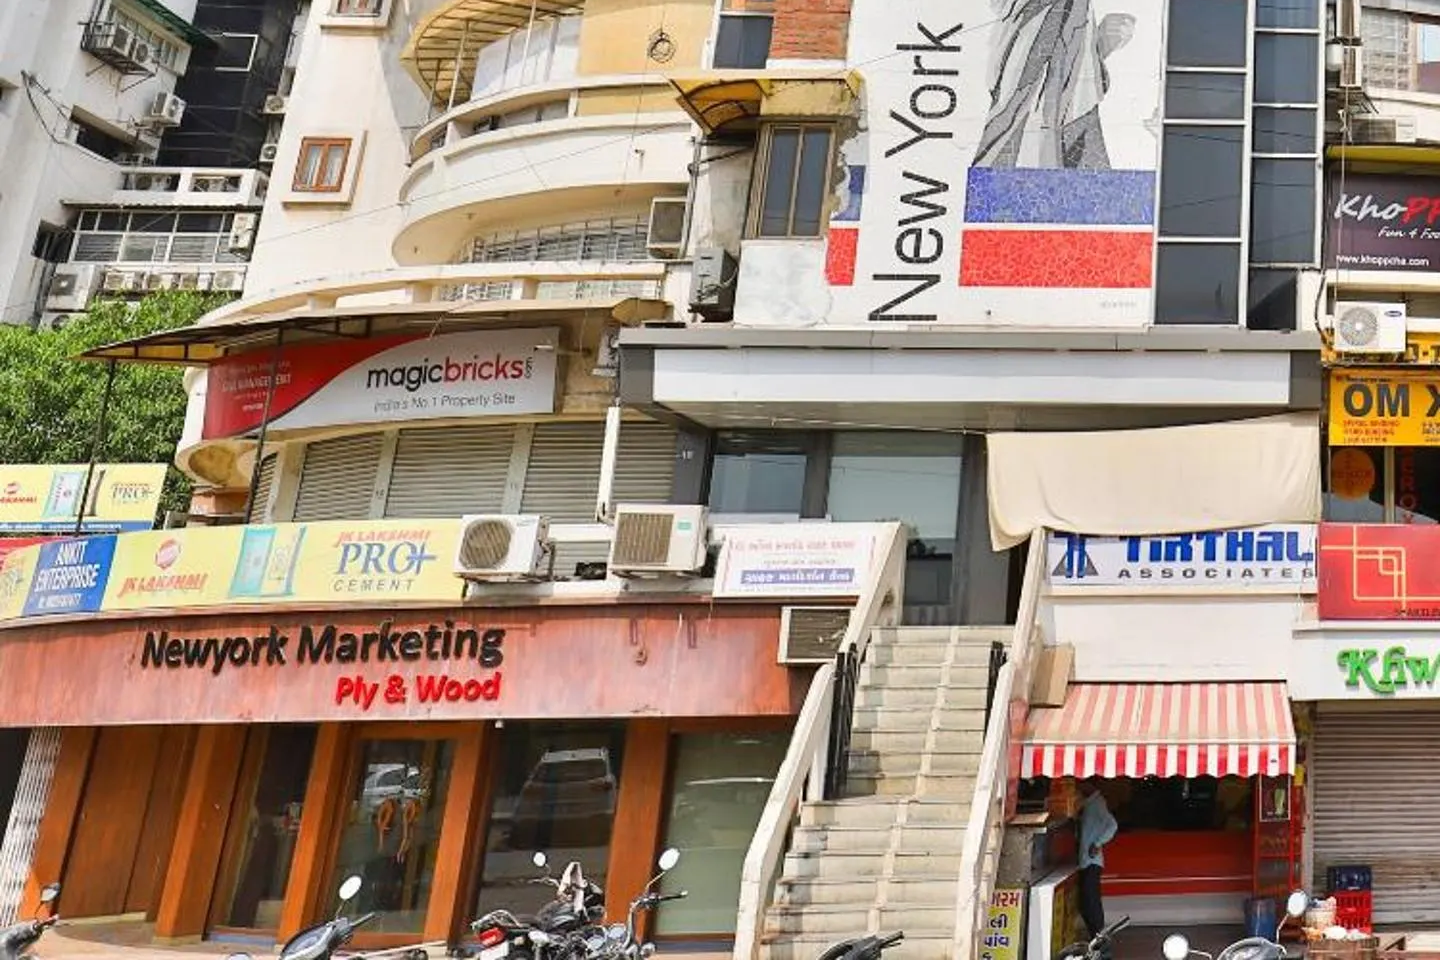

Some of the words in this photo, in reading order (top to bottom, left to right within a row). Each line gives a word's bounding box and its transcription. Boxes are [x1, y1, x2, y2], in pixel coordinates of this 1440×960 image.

[886, 22, 963, 158] York
[868, 170, 949, 322] New
[366, 352, 524, 392] magicbricks
[1343, 383, 1410, 418] OM
[333, 578, 414, 593] CEMENT
[140, 625, 290, 676] Newyork
[296, 619, 508, 669] Marketing
[334, 674, 380, 711] Ply
[383, 675, 407, 705] &
[414, 671, 502, 704] Wood
